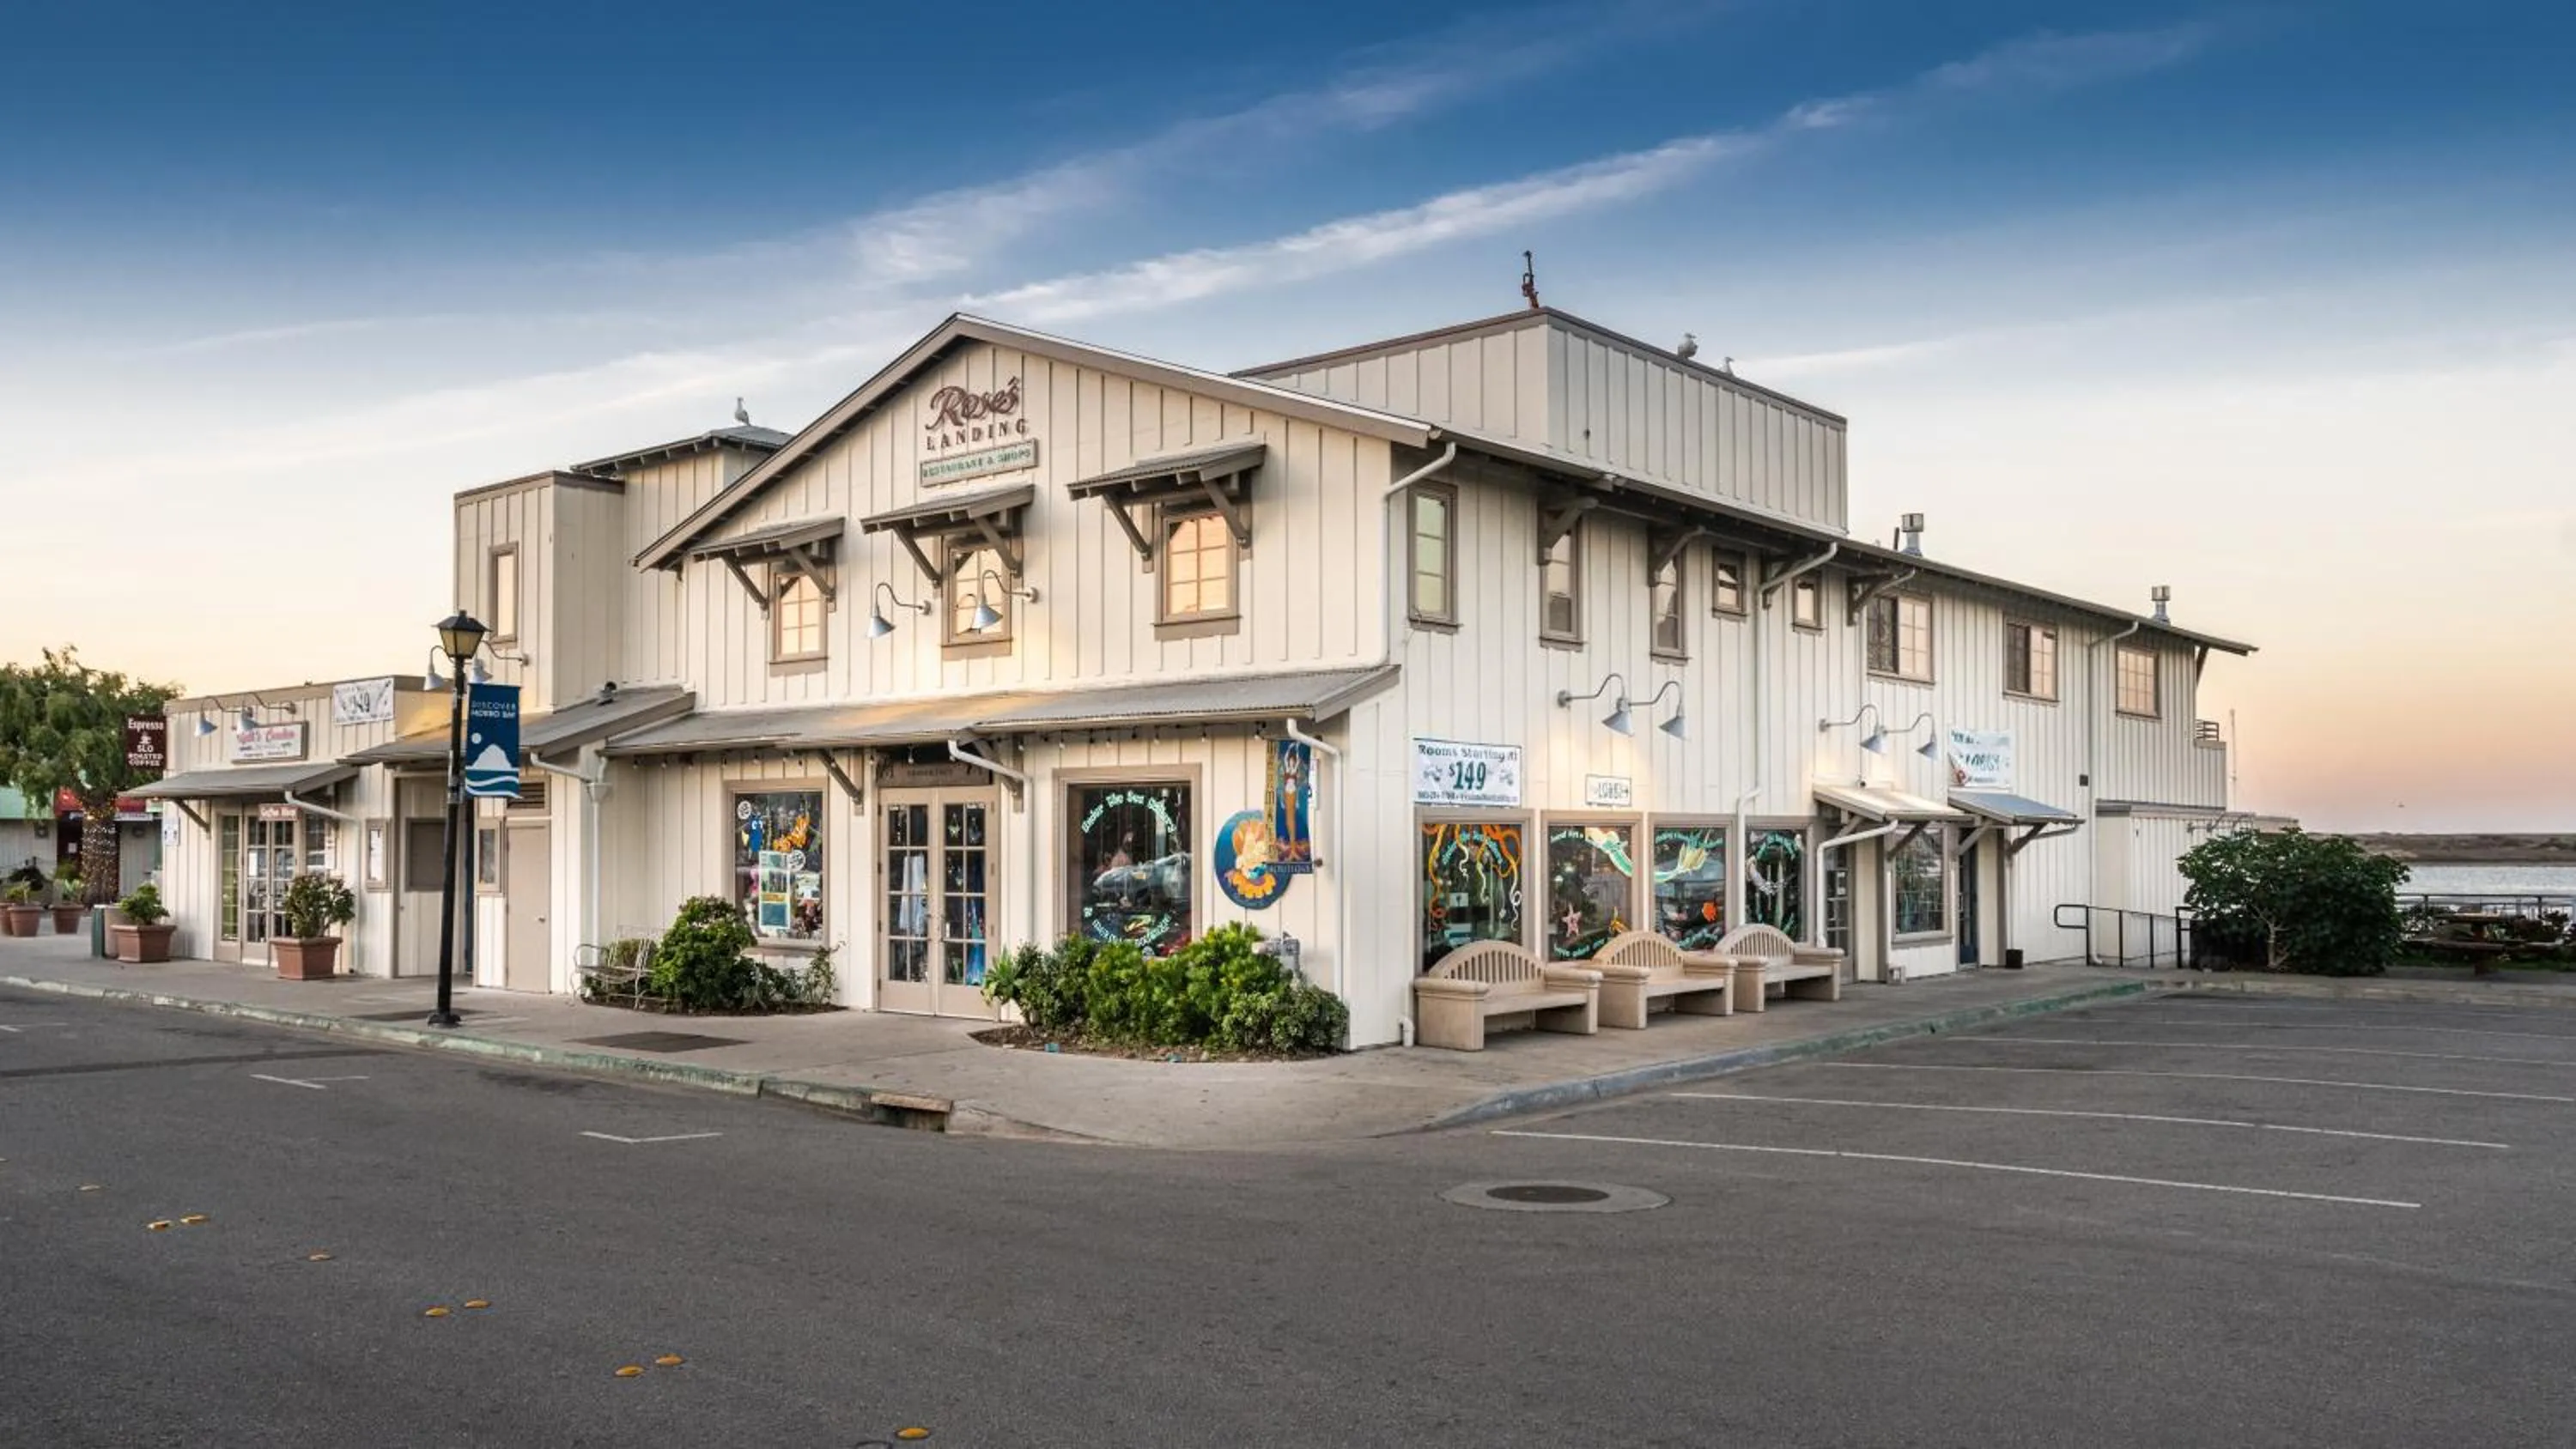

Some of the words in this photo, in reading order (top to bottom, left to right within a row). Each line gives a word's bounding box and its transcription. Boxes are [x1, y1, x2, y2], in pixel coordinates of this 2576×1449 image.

[925, 376, 1020, 430] Rose's
[927, 418, 1029, 451] LANDING
[997, 448, 1031, 462] SHOPS
[471, 700, 516, 711] DISCOVER
[128, 718, 164, 732] Espresso
[1419, 744, 1458, 756] Rooms
[1461, 749, 1505, 762] Starting
[1449, 761, 1486, 790] $149
